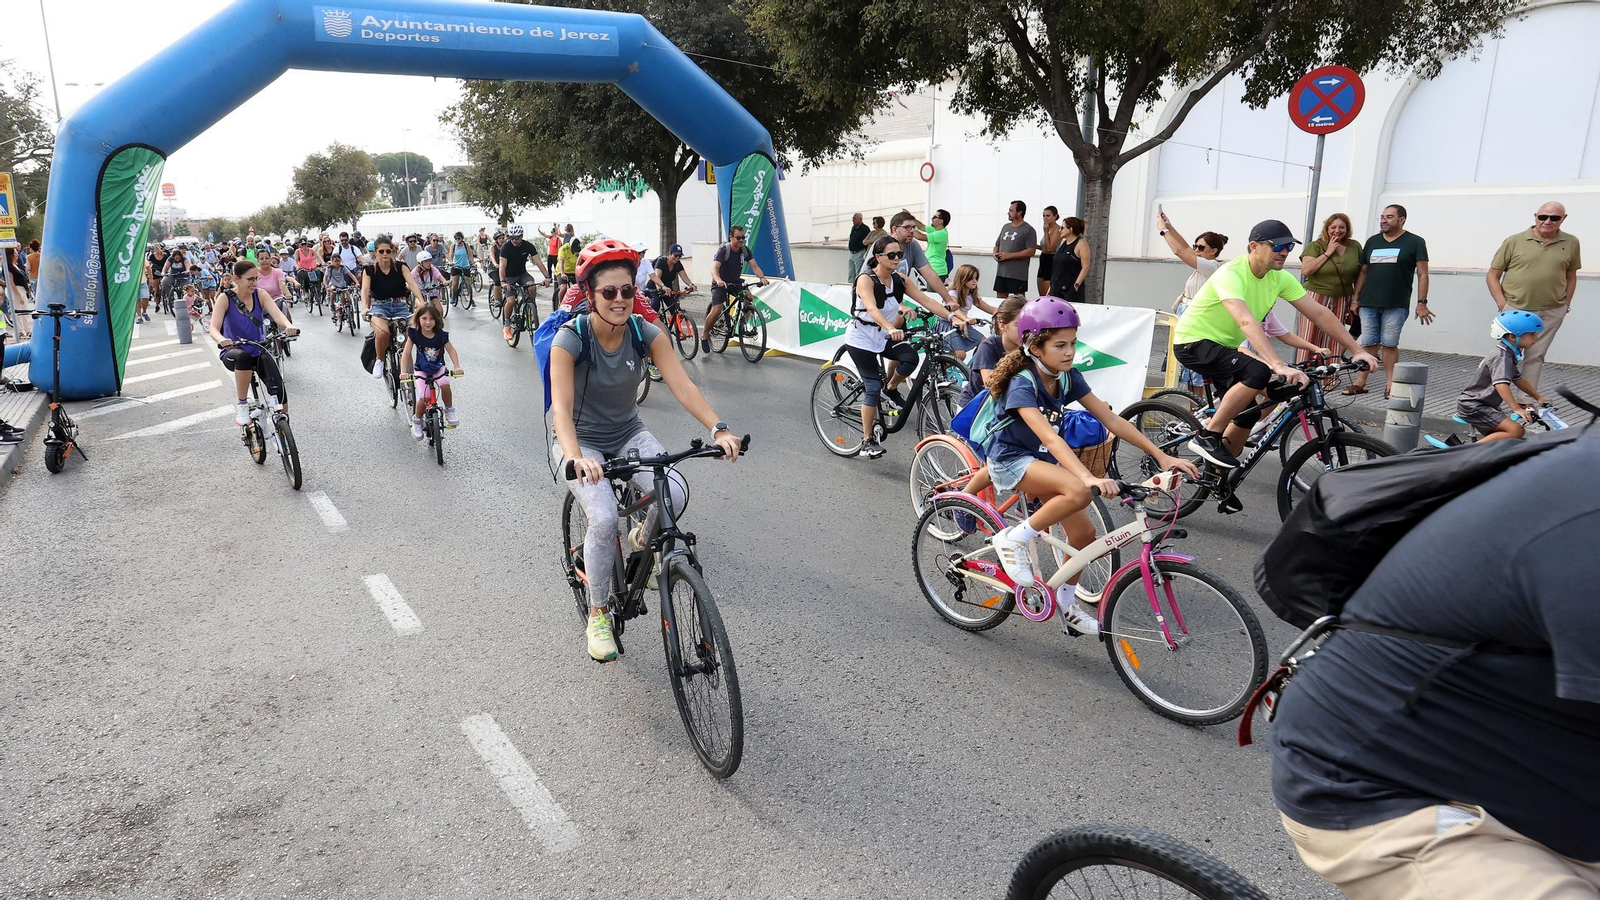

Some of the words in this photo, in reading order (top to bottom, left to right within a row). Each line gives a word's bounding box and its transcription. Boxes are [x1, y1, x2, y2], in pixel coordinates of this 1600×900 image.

[361, 15, 525, 36] Ayuntamiento
[529, 26, 554, 38] de
[559, 28, 610, 41] Jerez
[361, 29, 440, 43] Deportes
[122, 164, 152, 222] Inglés
[114, 265, 131, 284] El
[800, 310, 807, 323] El
[807, 311, 826, 326] Corte
